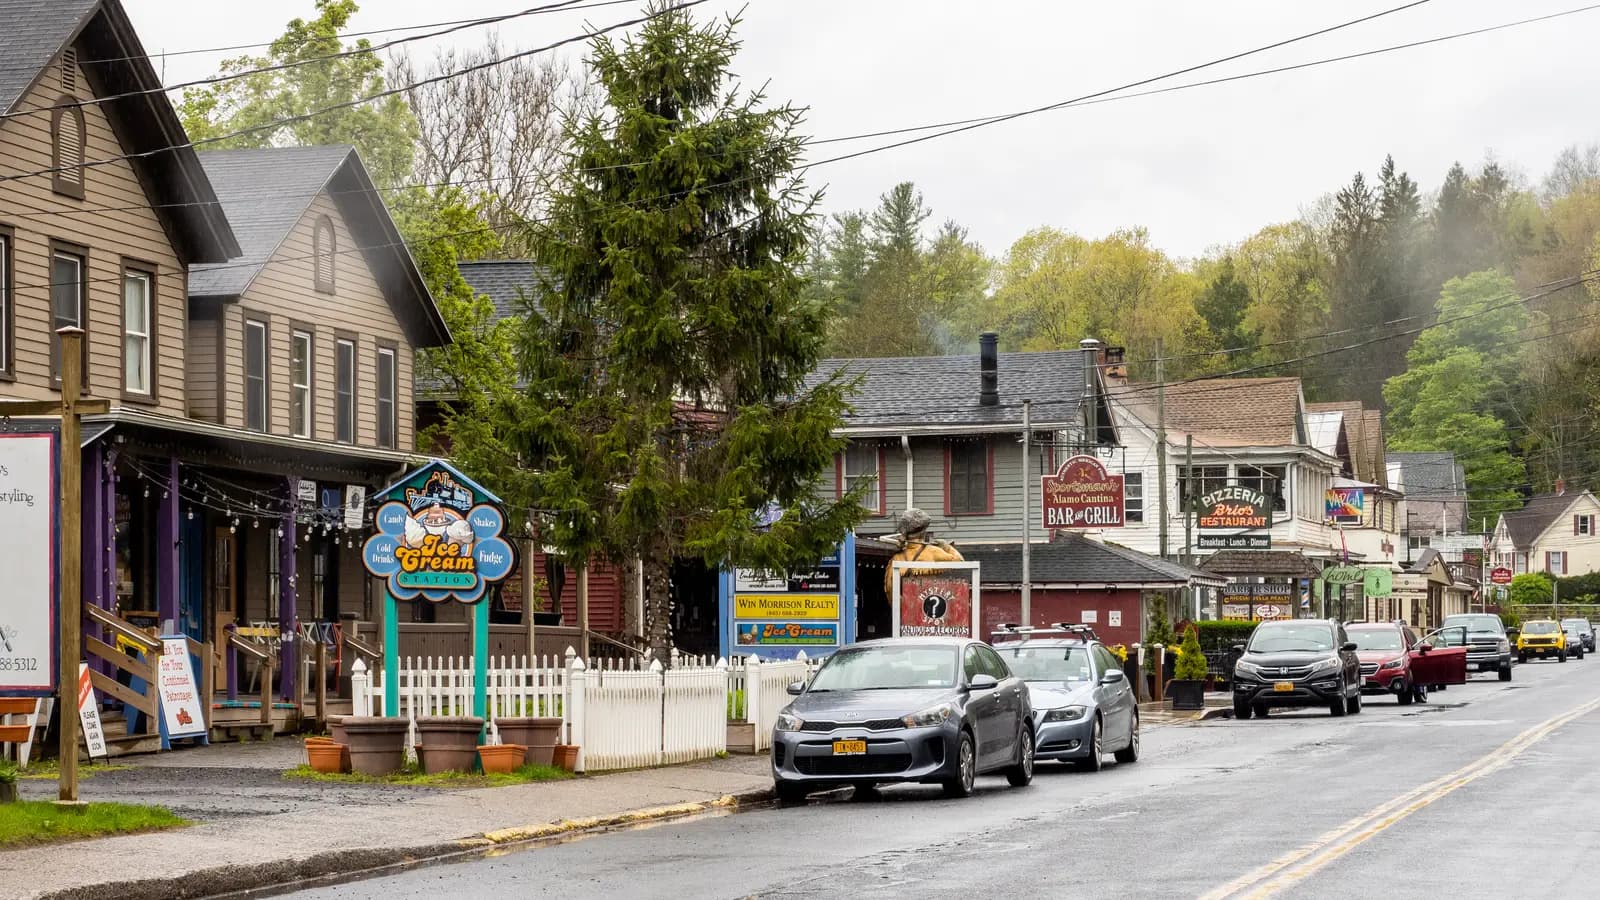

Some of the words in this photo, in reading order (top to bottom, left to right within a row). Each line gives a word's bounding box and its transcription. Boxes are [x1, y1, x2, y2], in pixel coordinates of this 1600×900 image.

[1046, 480, 1120, 495] Sportsman's
[1053, 495, 1080, 504] Alamo
[1080, 494, 1114, 504] Cantina
[1201, 487, 1265, 508] PIZZERIA
[1047, 507, 1074, 525] BAR
[1084, 506, 1120, 525] GRILL
[1211, 503, 1254, 516] Brio's
[384, 514, 403, 524] Candy
[473, 517, 497, 528] Shakes
[1200, 516, 1267, 527] RESTAURANT
[376, 543, 391, 553] Cold
[420, 534, 460, 557] Ice
[1200, 537, 1226, 547] Breakfast
[1229, 537, 1247, 547] Lunch
[1250, 538, 1268, 547] Dinner
[372, 554, 395, 564] Drinks
[395, 546, 474, 572] Cream
[479, 549, 504, 565] Fudge
[1325, 563, 1361, 582] home
[402, 576, 472, 584] STATION
[1264, 585, 1290, 593] SHOP
[763, 623, 786, 638] Ice
[786, 623, 833, 638] Cream
